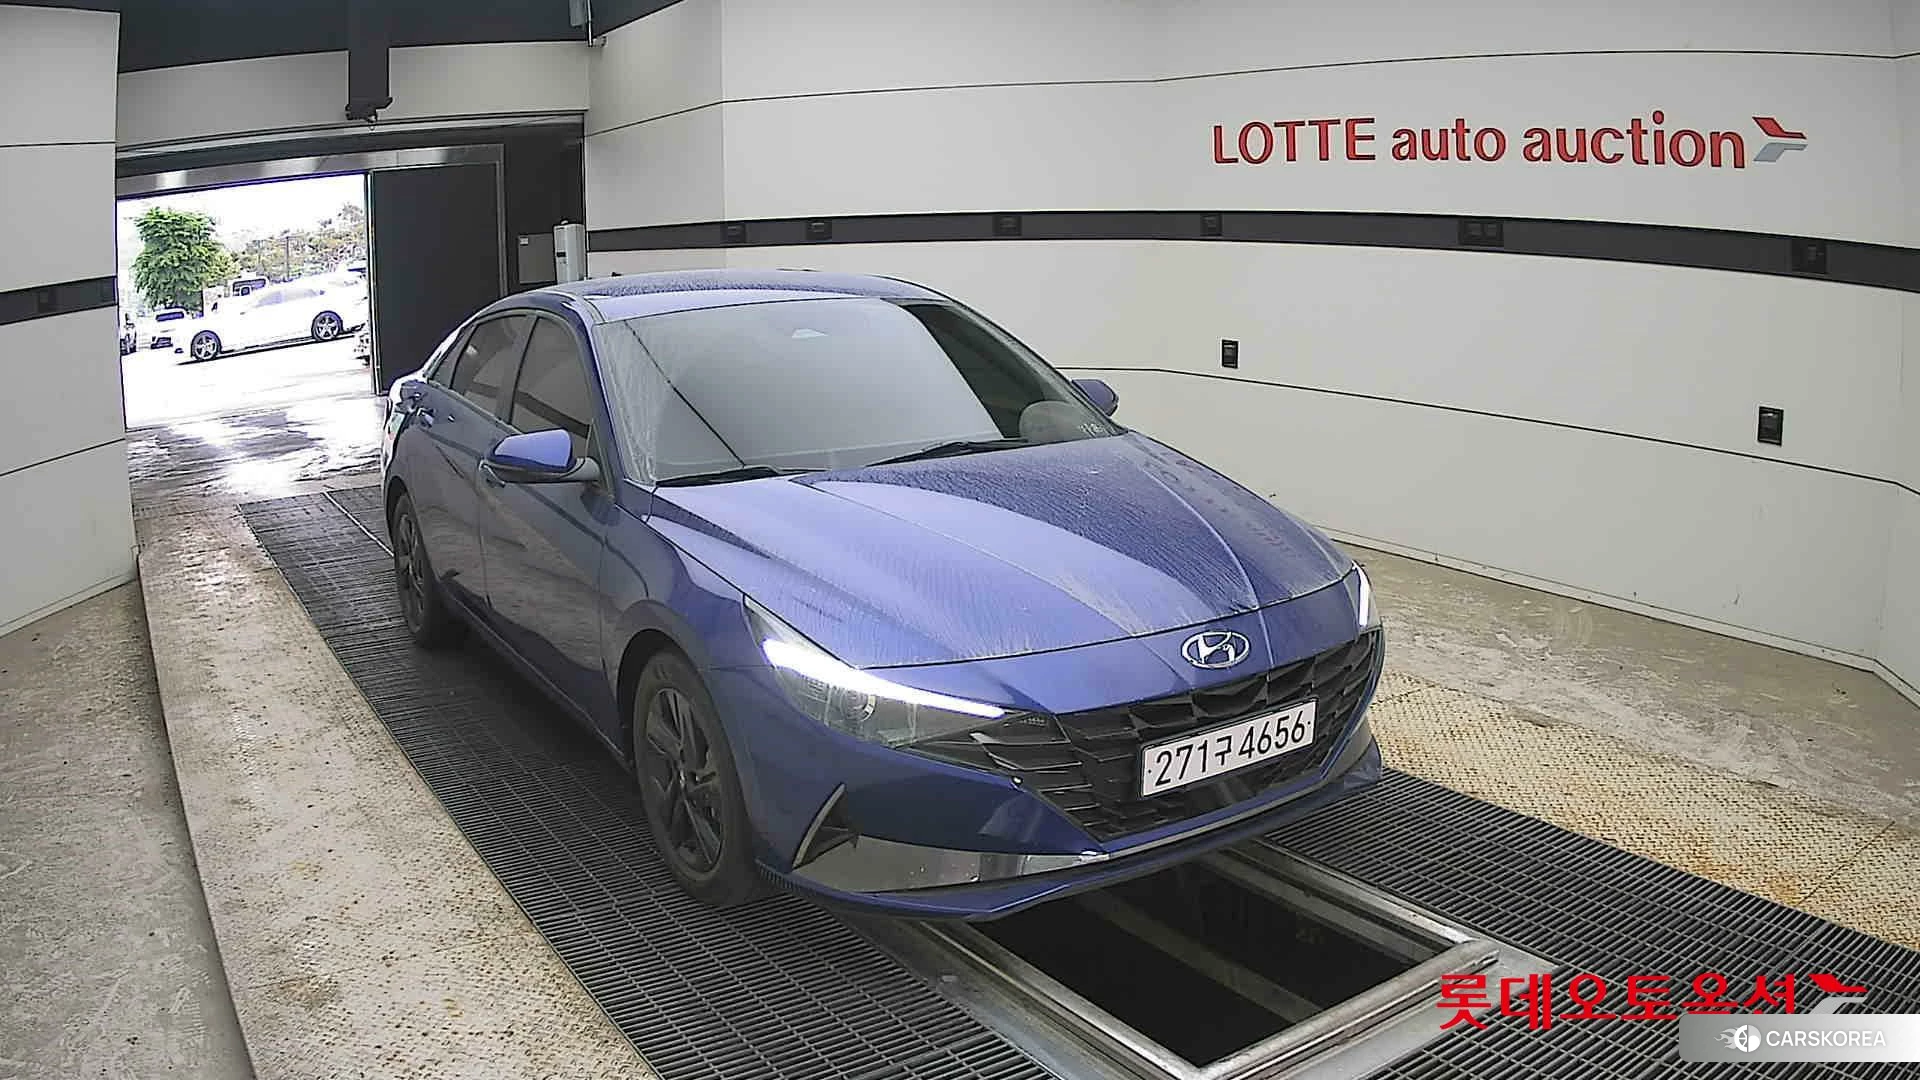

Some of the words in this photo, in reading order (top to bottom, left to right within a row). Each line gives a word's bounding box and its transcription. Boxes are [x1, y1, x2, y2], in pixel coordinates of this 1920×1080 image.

[1213, 117, 1376, 165] LOTTE
[1391, 117, 1507, 162] auto
[1522, 109, 1745, 169] auction
